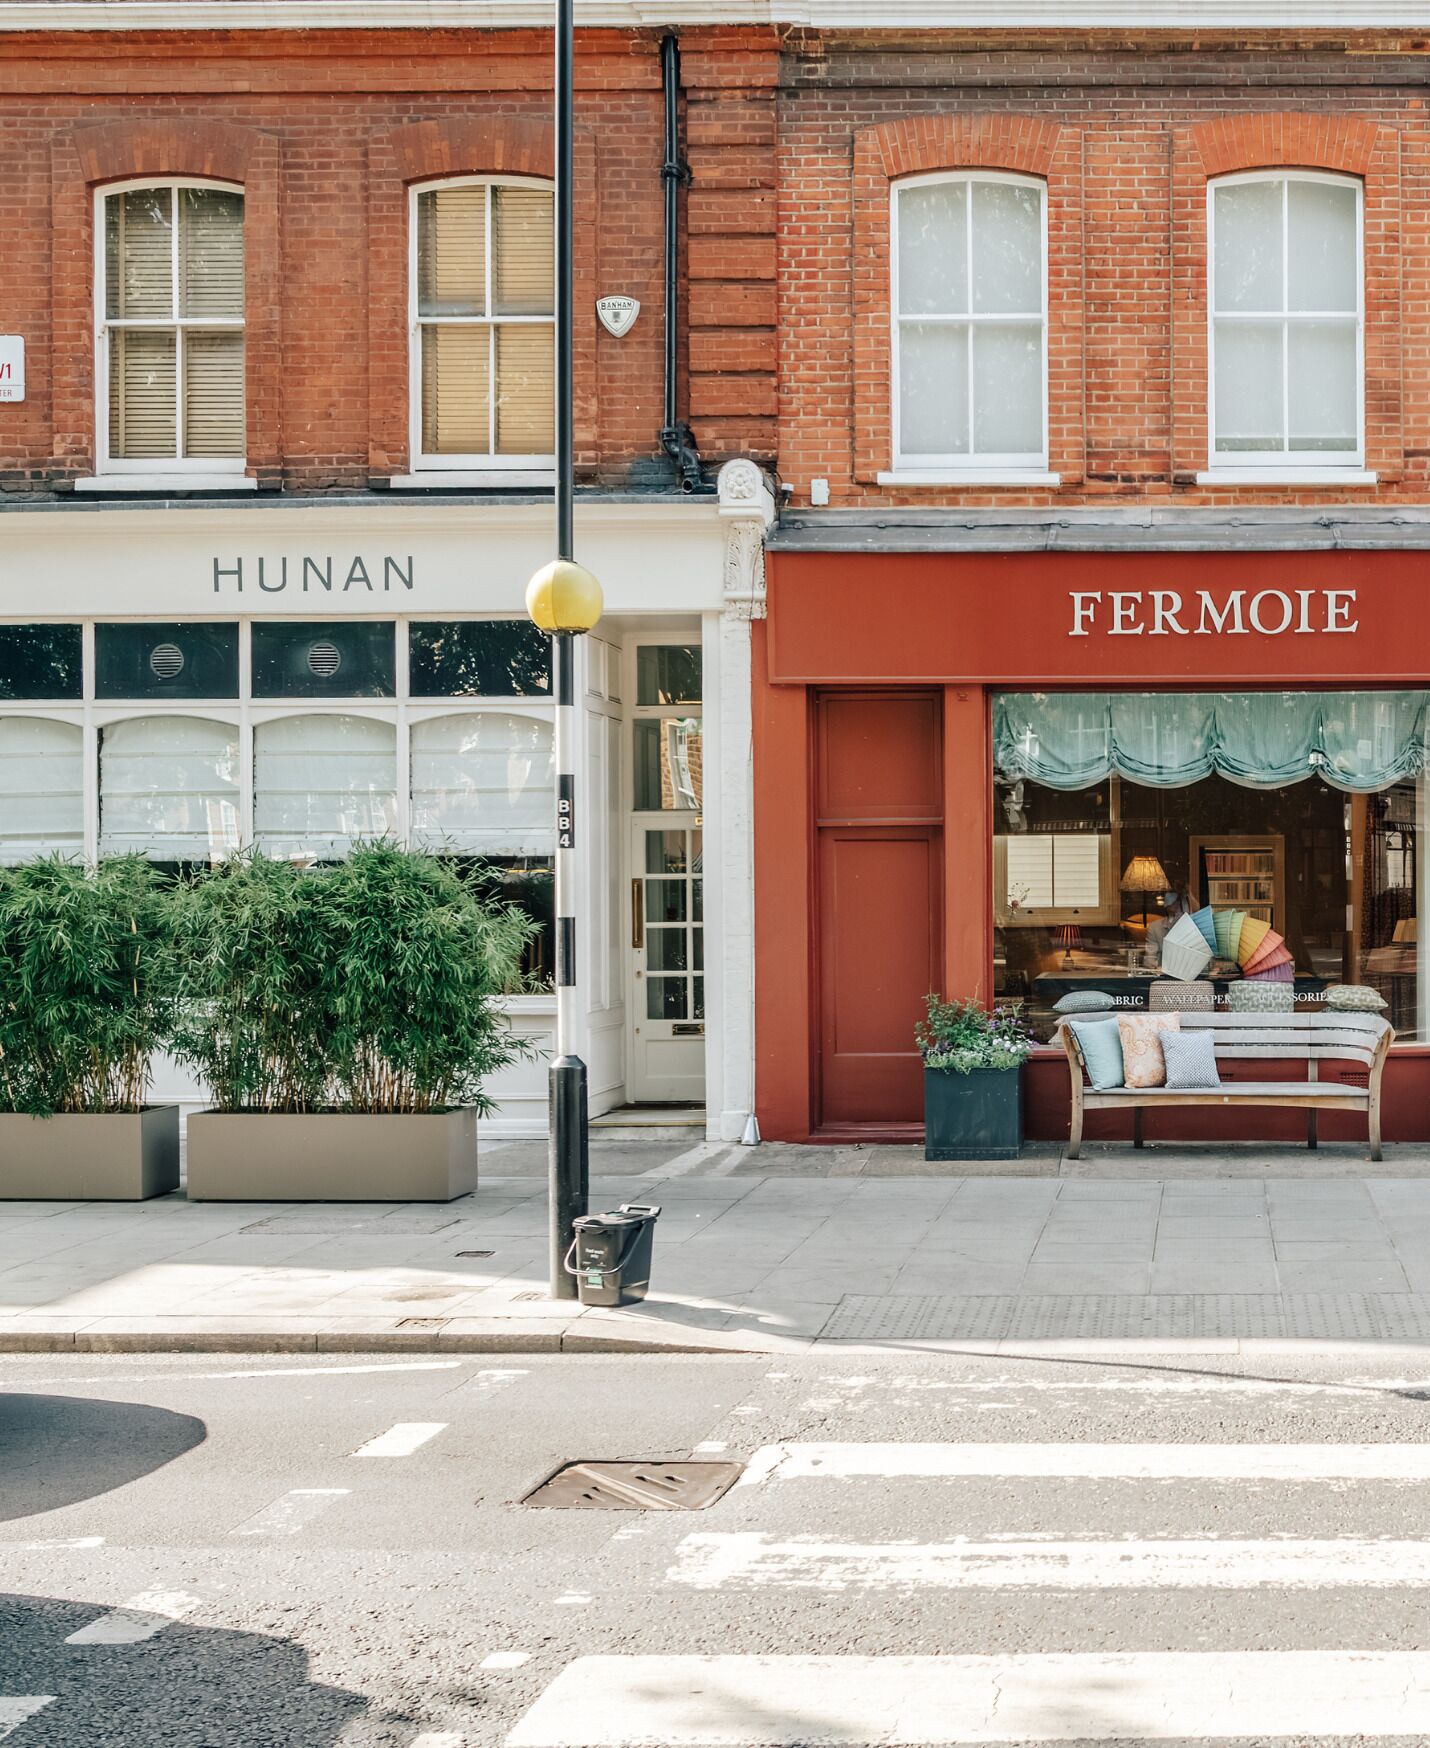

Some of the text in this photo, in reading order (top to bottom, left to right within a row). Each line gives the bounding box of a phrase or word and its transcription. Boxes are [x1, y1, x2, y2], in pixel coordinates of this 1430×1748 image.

[600, 300, 632, 311] BANHAM
[213, 555, 414, 593] HUNAN
[1068, 589, 1360, 636] FERMOIE
[559, 799, 570, 848] BB4
